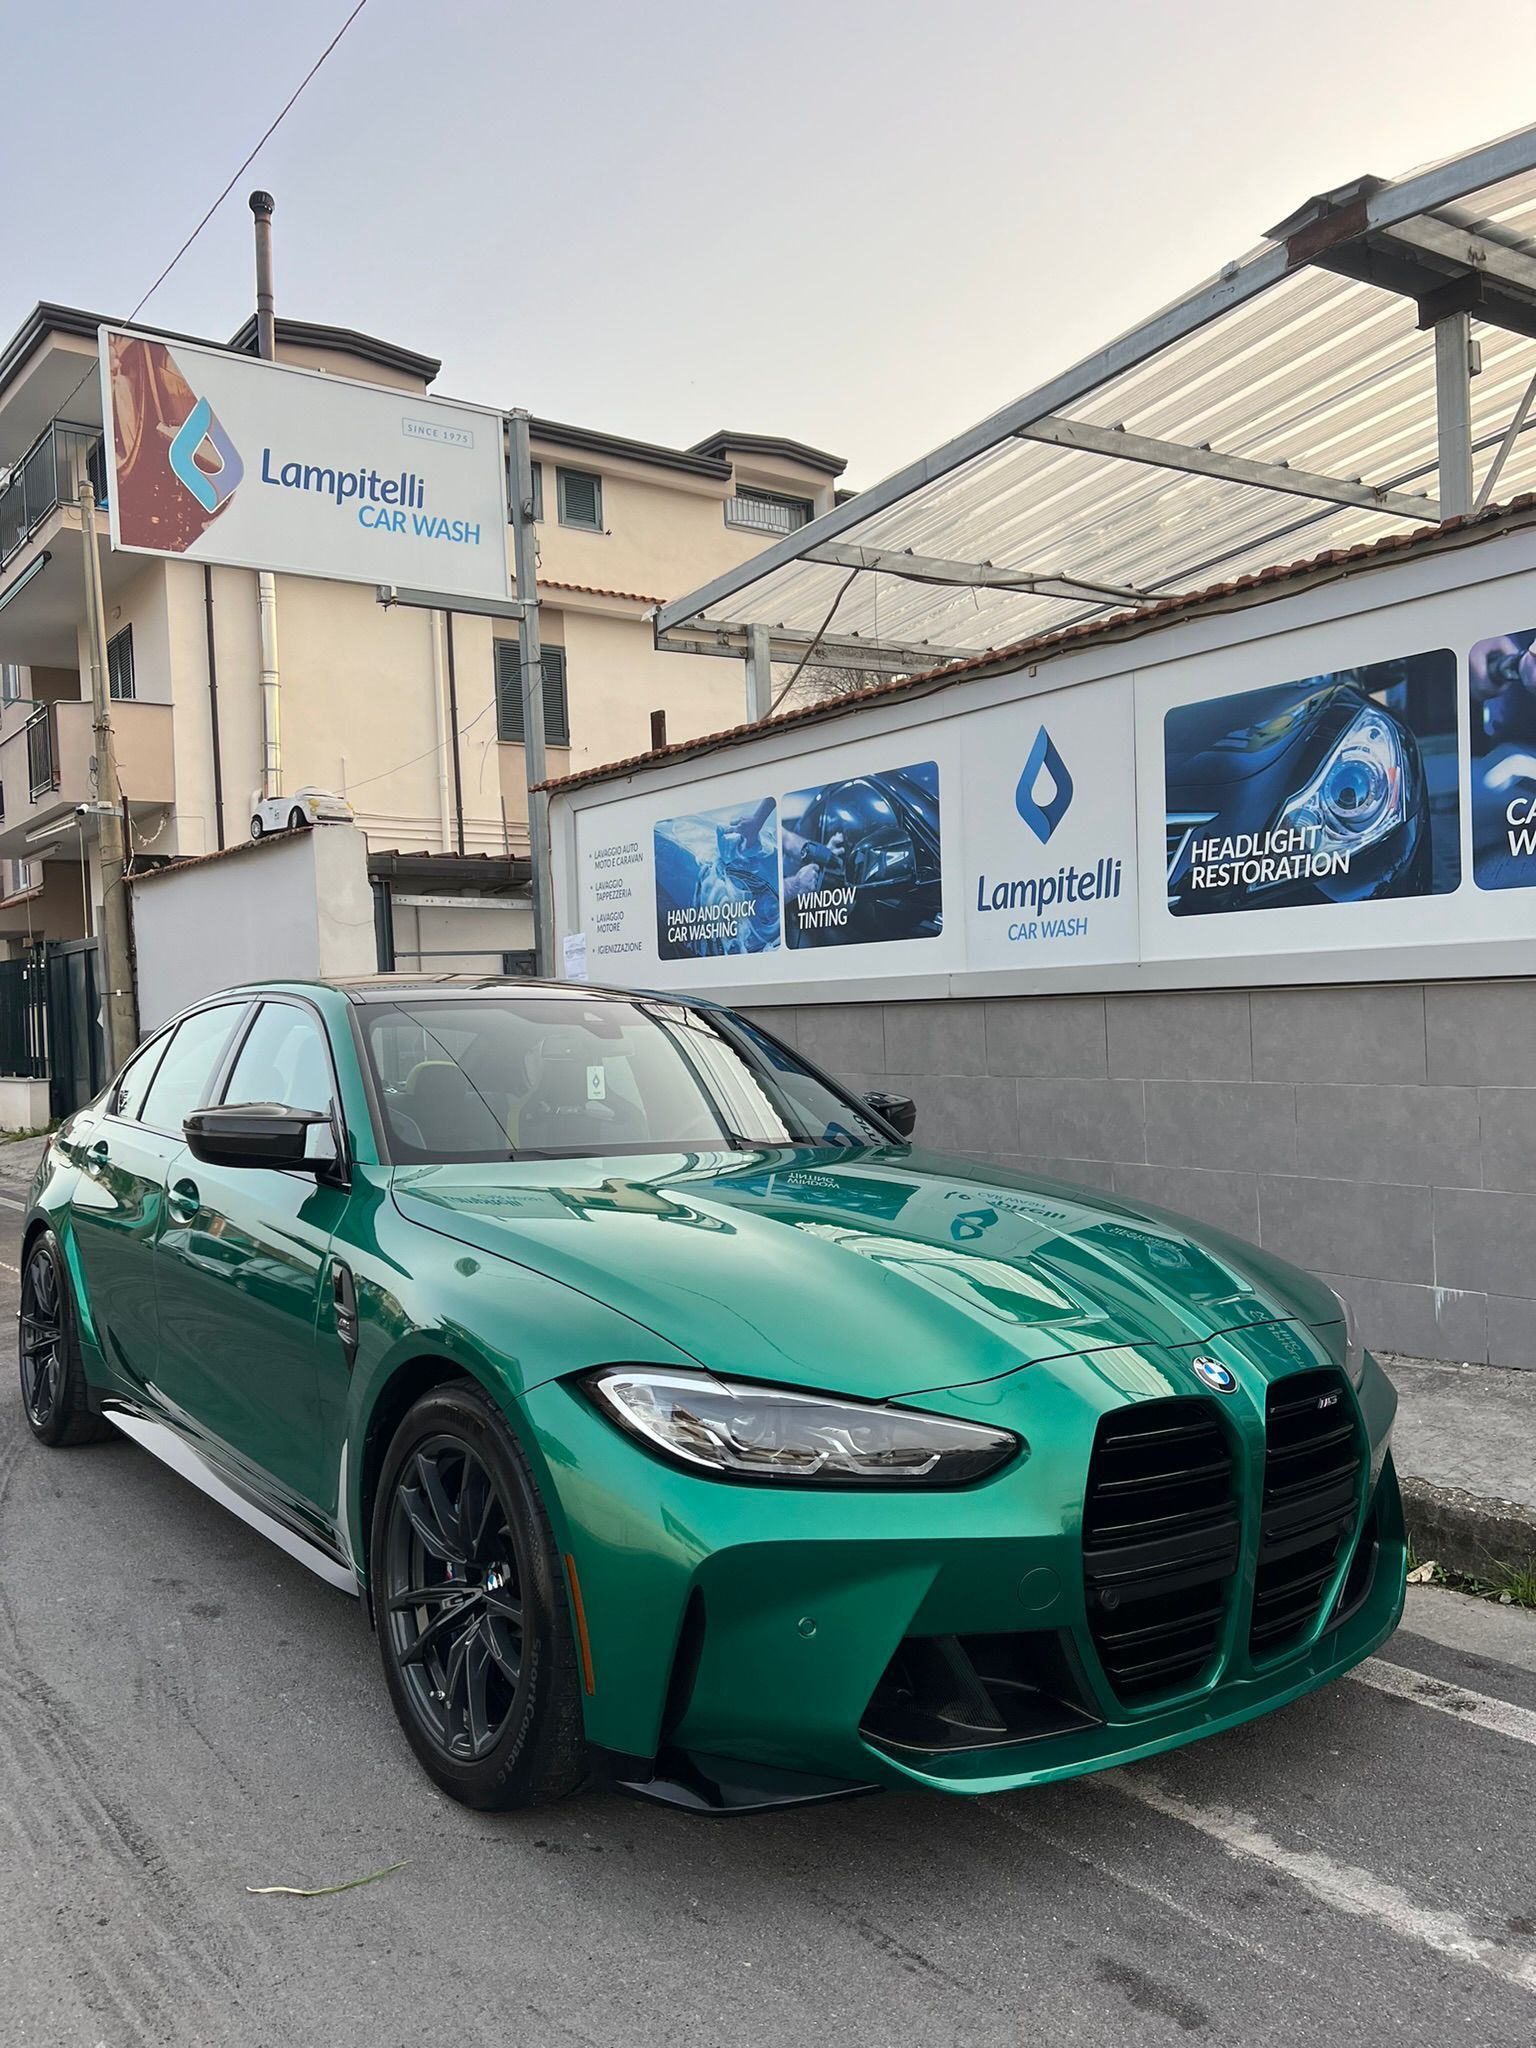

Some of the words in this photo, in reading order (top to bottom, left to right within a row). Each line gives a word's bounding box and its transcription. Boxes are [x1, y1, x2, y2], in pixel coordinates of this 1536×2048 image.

[407, 424, 439, 438] SINCE
[443, 431, 469, 443] 1975
[261, 448, 425, 509] Lampitelli
[358, 505, 407, 533] CAR
[412, 513, 481, 545] WASH
[594, 846, 622, 860] LAVAGGIO
[623, 842, 639, 854] AUTO
[1191, 824, 1323, 864] HEADLIGHT
[595, 858, 612, 870] MOTO
[612, 858, 616, 867] E
[616, 853, 644, 866] CARAVAN
[1191, 850, 1351, 889] RESTORATION
[595, 878, 623, 892] LAVAGGIO
[596, 888, 632, 902] TAPPEZZERIA
[977, 857, 1122, 917] Lampitelli
[797, 886, 858, 910] WINDOW
[596, 911, 625, 923] LAVAGGIO
[667, 906, 696, 926] HAND
[698, 904, 721, 922] AND
[721, 900, 757, 921] QUICK
[797, 907, 848, 930] TINTING
[597, 922, 621, 933] MOTORE
[667, 926, 688, 943] CAR
[688, 920, 738, 941] WASHING
[1008, 922, 1038, 941] CAR
[1041, 917, 1088, 938] WASH
[597, 942, 643, 955] IGIENIZZAZIONE
